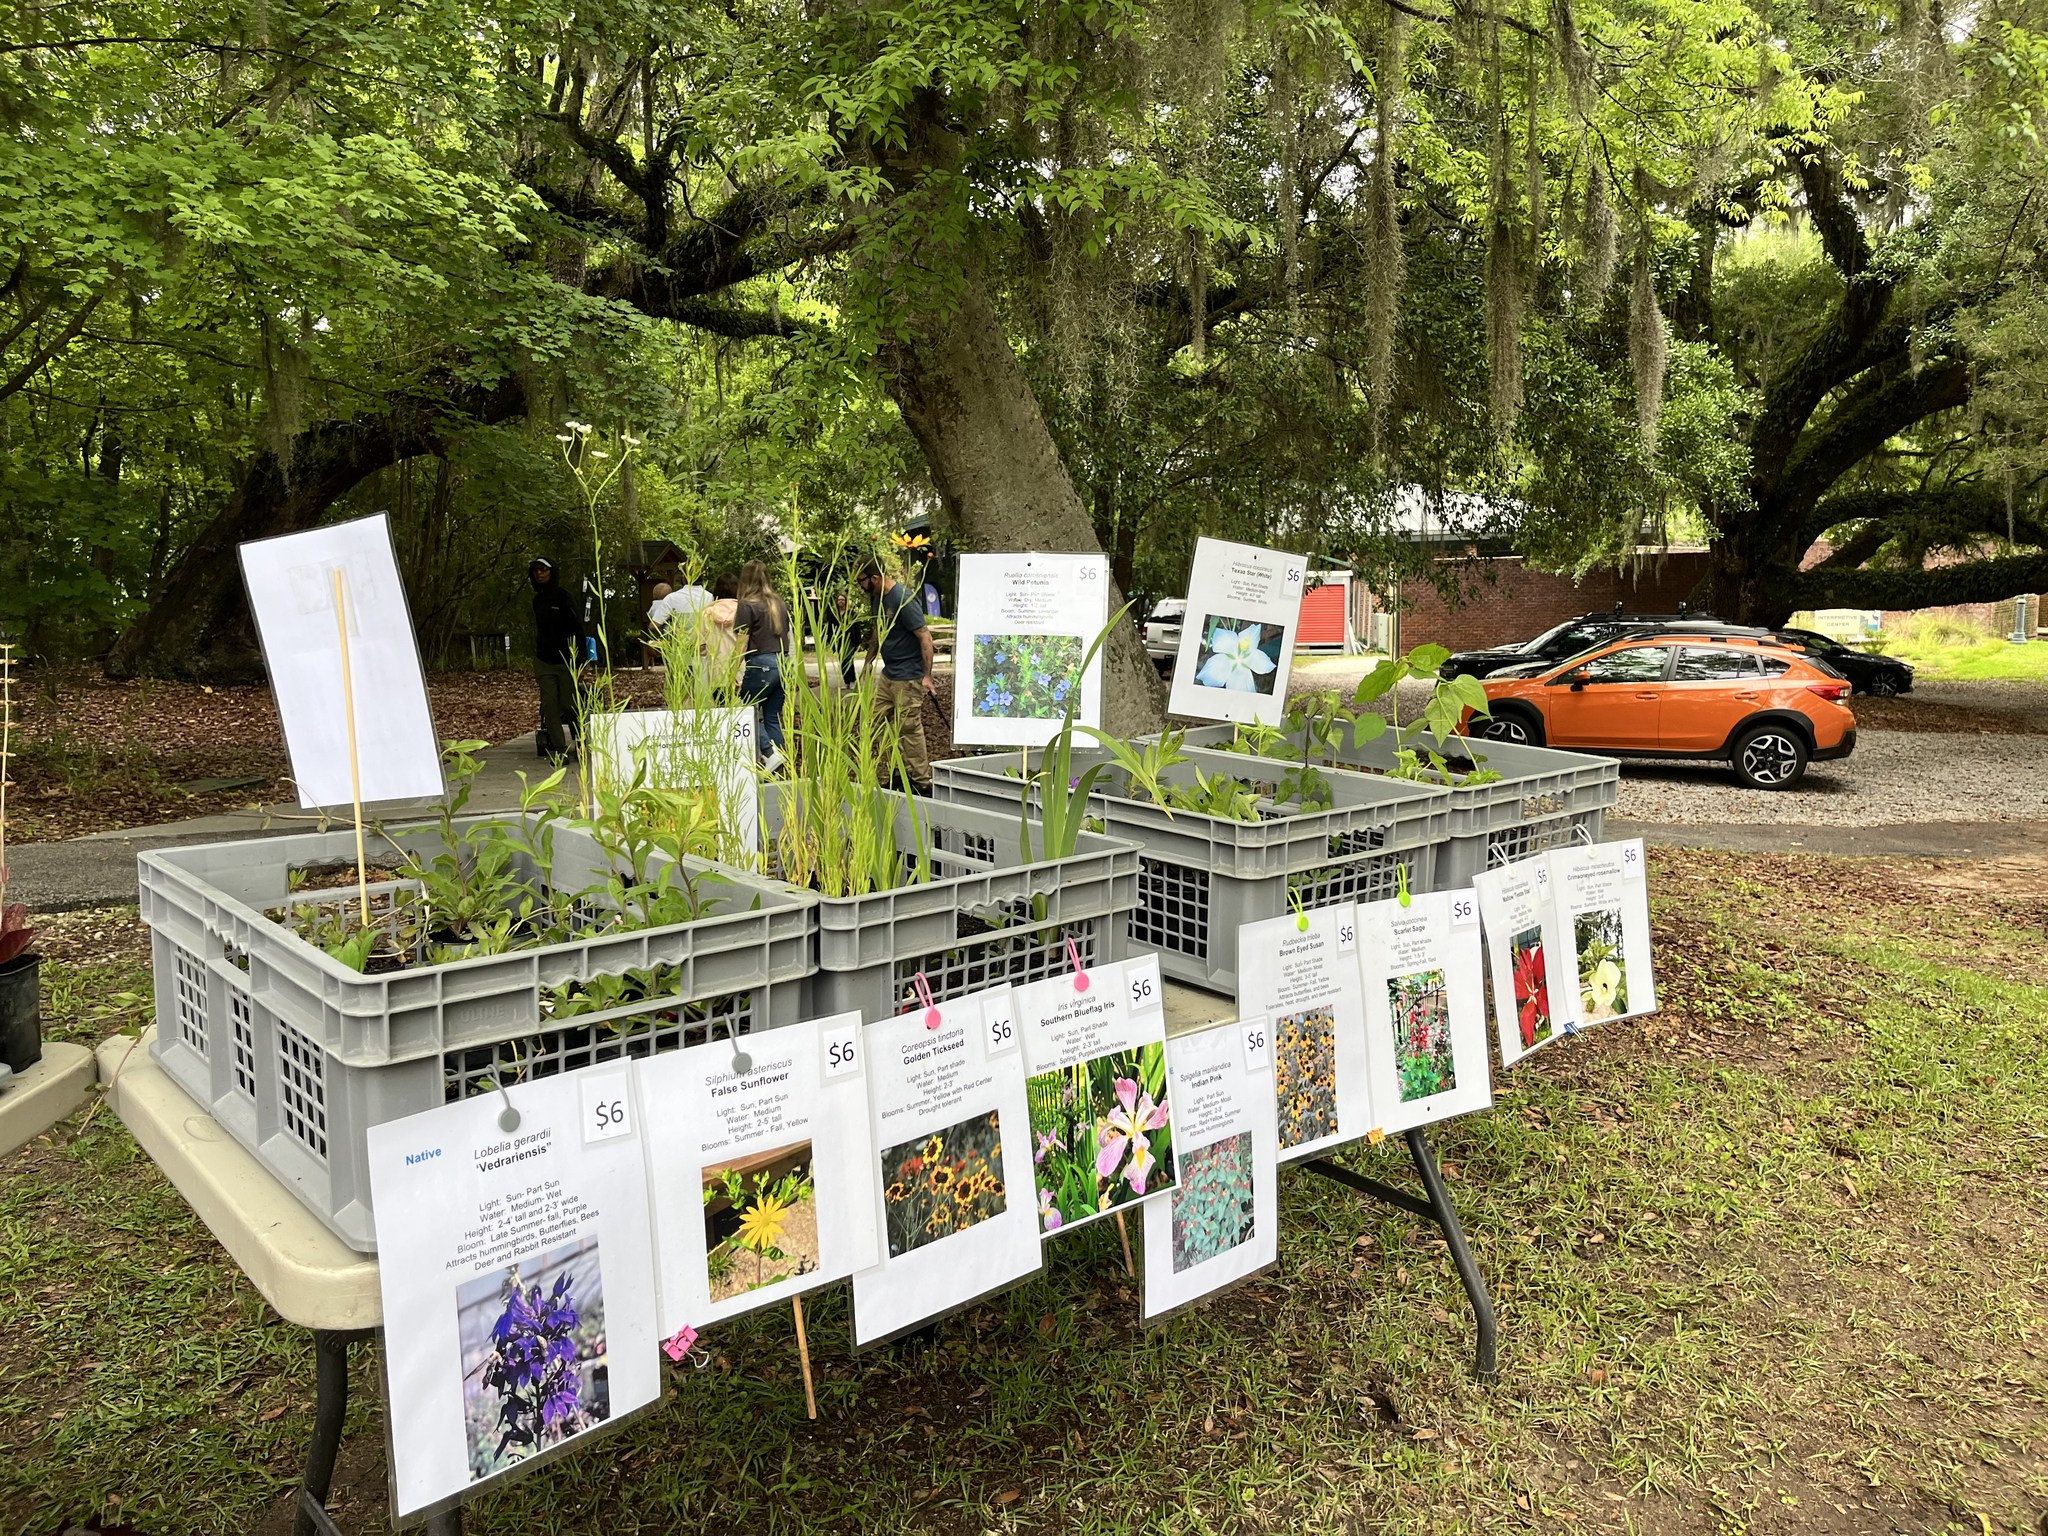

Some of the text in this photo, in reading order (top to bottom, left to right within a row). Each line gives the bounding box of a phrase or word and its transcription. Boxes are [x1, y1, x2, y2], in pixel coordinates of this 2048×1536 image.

[1080, 566, 1096, 581] $6
[1288, 568, 1299, 581] $6
[734, 722, 750, 739] $6
[1624, 849, 1636, 863] $6
[1538, 869, 1547, 884] $6
[1454, 901, 1471, 919] $6
[1341, 926, 1353, 944] $6
[1394, 927, 1412, 936] Scarlet
[1279, 942, 1324, 957] Brown Eyed Susan
[1132, 979, 1150, 1001] $6
[1041, 1001, 1115, 1027] Southern Blueflag Iris
[1058, 1003, 1068, 1011] Iris
[902, 1028, 964, 1054] Coreopsis tinctoria
[992, 1020, 1011, 1044] $6
[1248, 1031, 1264, 1052] $6
[829, 1042, 854, 1068] $6
[904, 1039, 964, 1065] Golden Tickseed
[748, 1059, 793, 1076] asteriscus
[937, 1064, 949, 1073] Part
[950, 1060, 965, 1069] shade
[937, 1071, 959, 1082] Medium
[711, 1073, 789, 1098] False Sunflower
[1192, 1074, 1222, 1088] Indian Pink
[906, 1098, 932, 1111] Summer,
[933, 1092, 951, 1101] Yellow
[952, 1087, 963, 1095] with
[964, 1082, 975, 1091] Red
[975, 1076, 993, 1087] Center
[596, 1100, 624, 1130] $6
[717, 1094, 789, 1118] Light: Sun, Part Sun
[726, 1106, 782, 1125] Water: Medium
[918, 1096, 962, 1116] Drought tolerant
[728, 1122, 753, 1134] Height:
[772, 1114, 782, 1123] tall
[474, 1128, 551, 1160] Lobelia gerardii
[702, 1140, 729, 1152] Blooms:
[734, 1130, 764, 1143] Summer
[770, 1123, 785, 1133] Fall,
[786, 1118, 808, 1128] Yellow
[405, 1147, 442, 1166] Native
[479, 1180, 560, 1212] Light: Sun- Part Sun
[480, 1189, 562, 1223] Water: Medium- Wet
[465, 1196, 579, 1240] Height: 2-4' tall and 2-3' wide
[457, 1204, 587, 1254] Bloom: Late Summer- fall, Purple
[446, 1210, 600, 1270] Attracts hummingbirds, Butterflies, Bees
[475, 1228, 576, 1271] Deer and Rabbit Resistant
